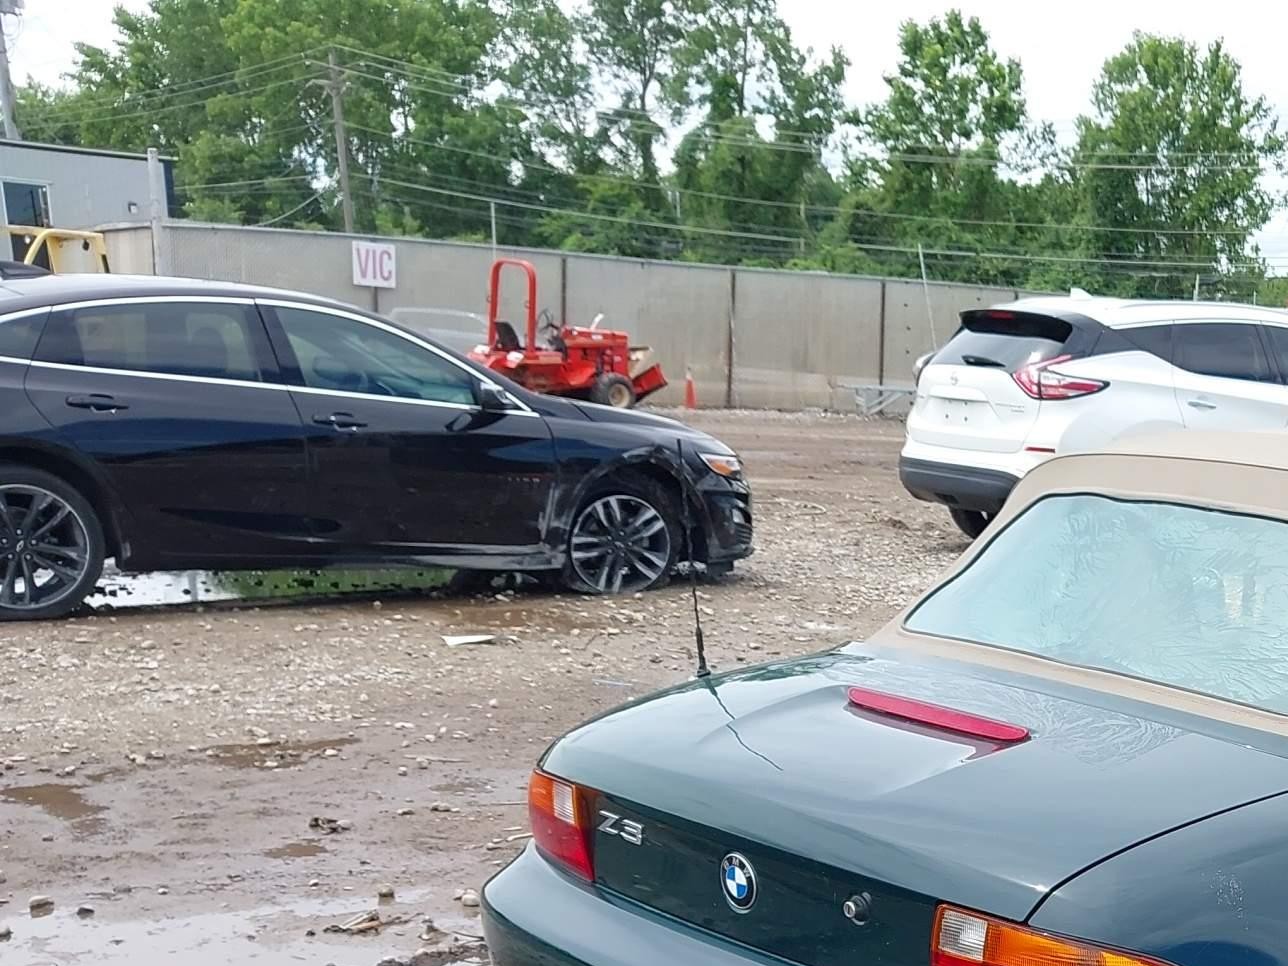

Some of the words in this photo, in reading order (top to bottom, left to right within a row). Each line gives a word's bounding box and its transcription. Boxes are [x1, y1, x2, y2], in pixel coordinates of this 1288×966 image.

[356, 248, 392, 281] VIC
[597, 810, 643, 846] Z3
[723, 856, 751, 878] BMW
